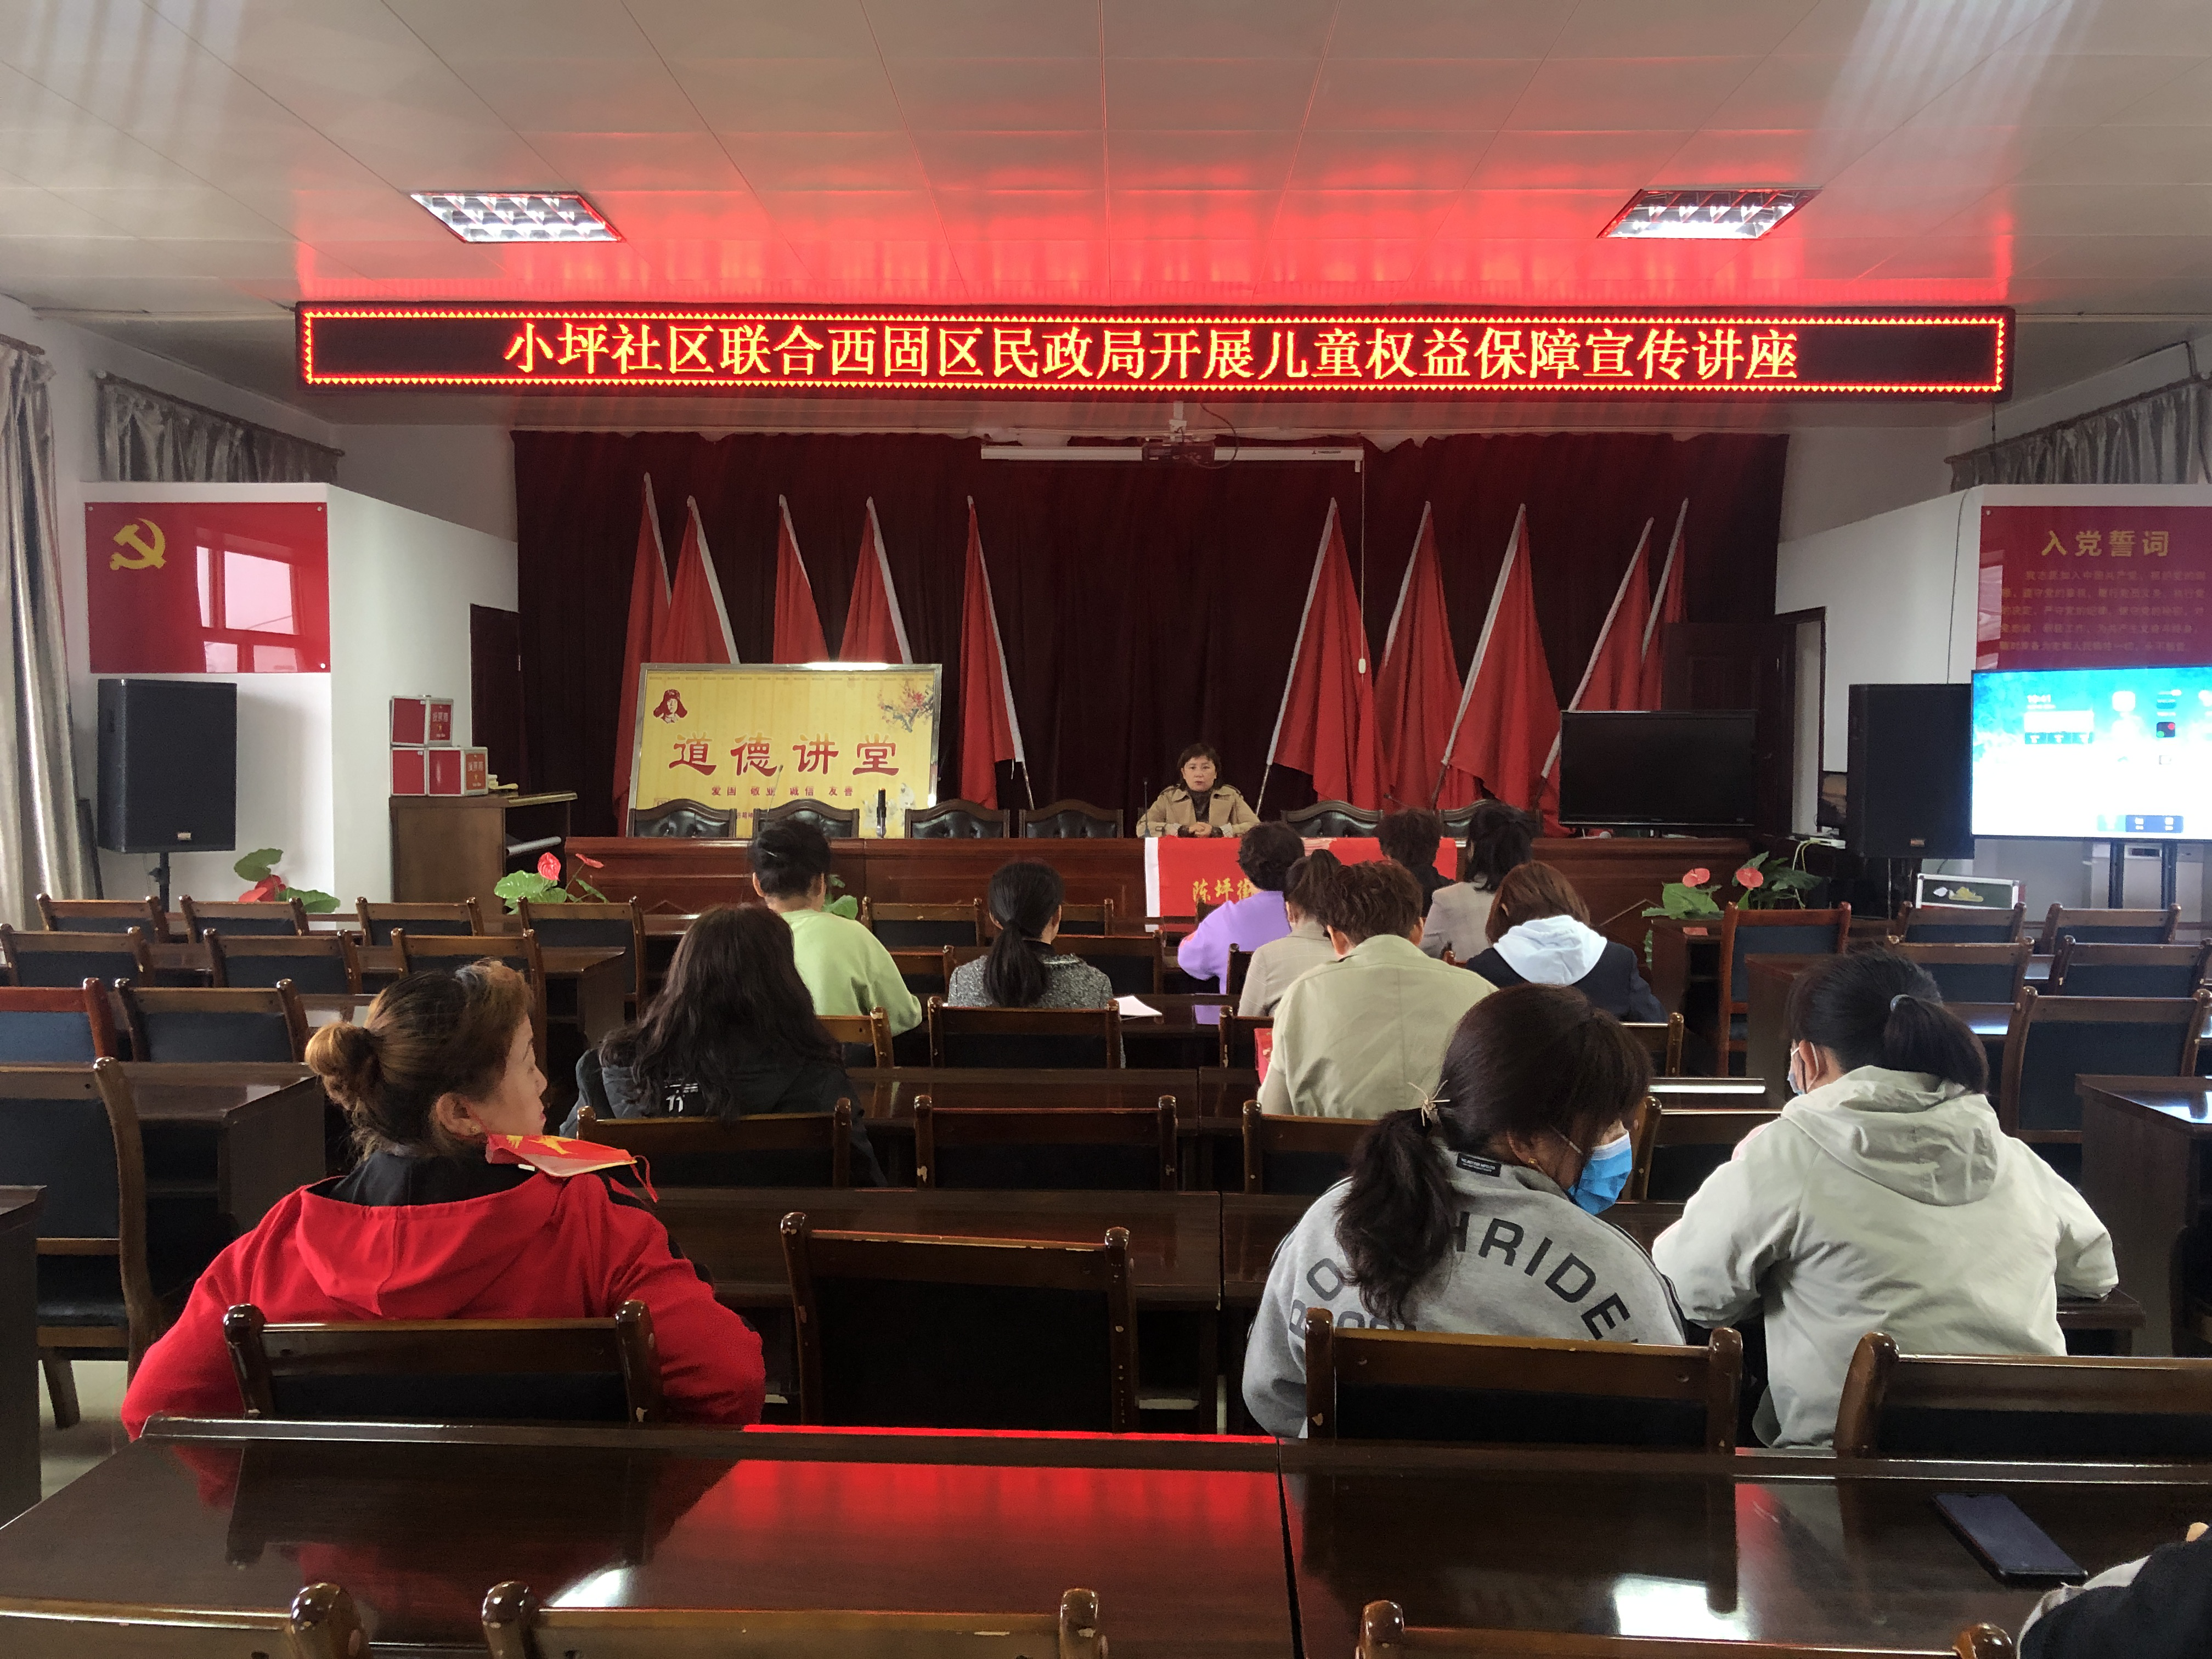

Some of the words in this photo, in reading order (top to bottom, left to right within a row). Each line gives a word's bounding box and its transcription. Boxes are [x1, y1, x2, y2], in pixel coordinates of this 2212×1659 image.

[504, 323, 1798, 380] 小坪社区联合西固区民政局开展儿童权益保障宣传讲座
[2041, 530, 2170, 557] 入党誓词
[668, 732, 899, 777] 道德讲堂
[789, 786, 815, 796] 诚信
[828, 786, 853, 796] 友善
